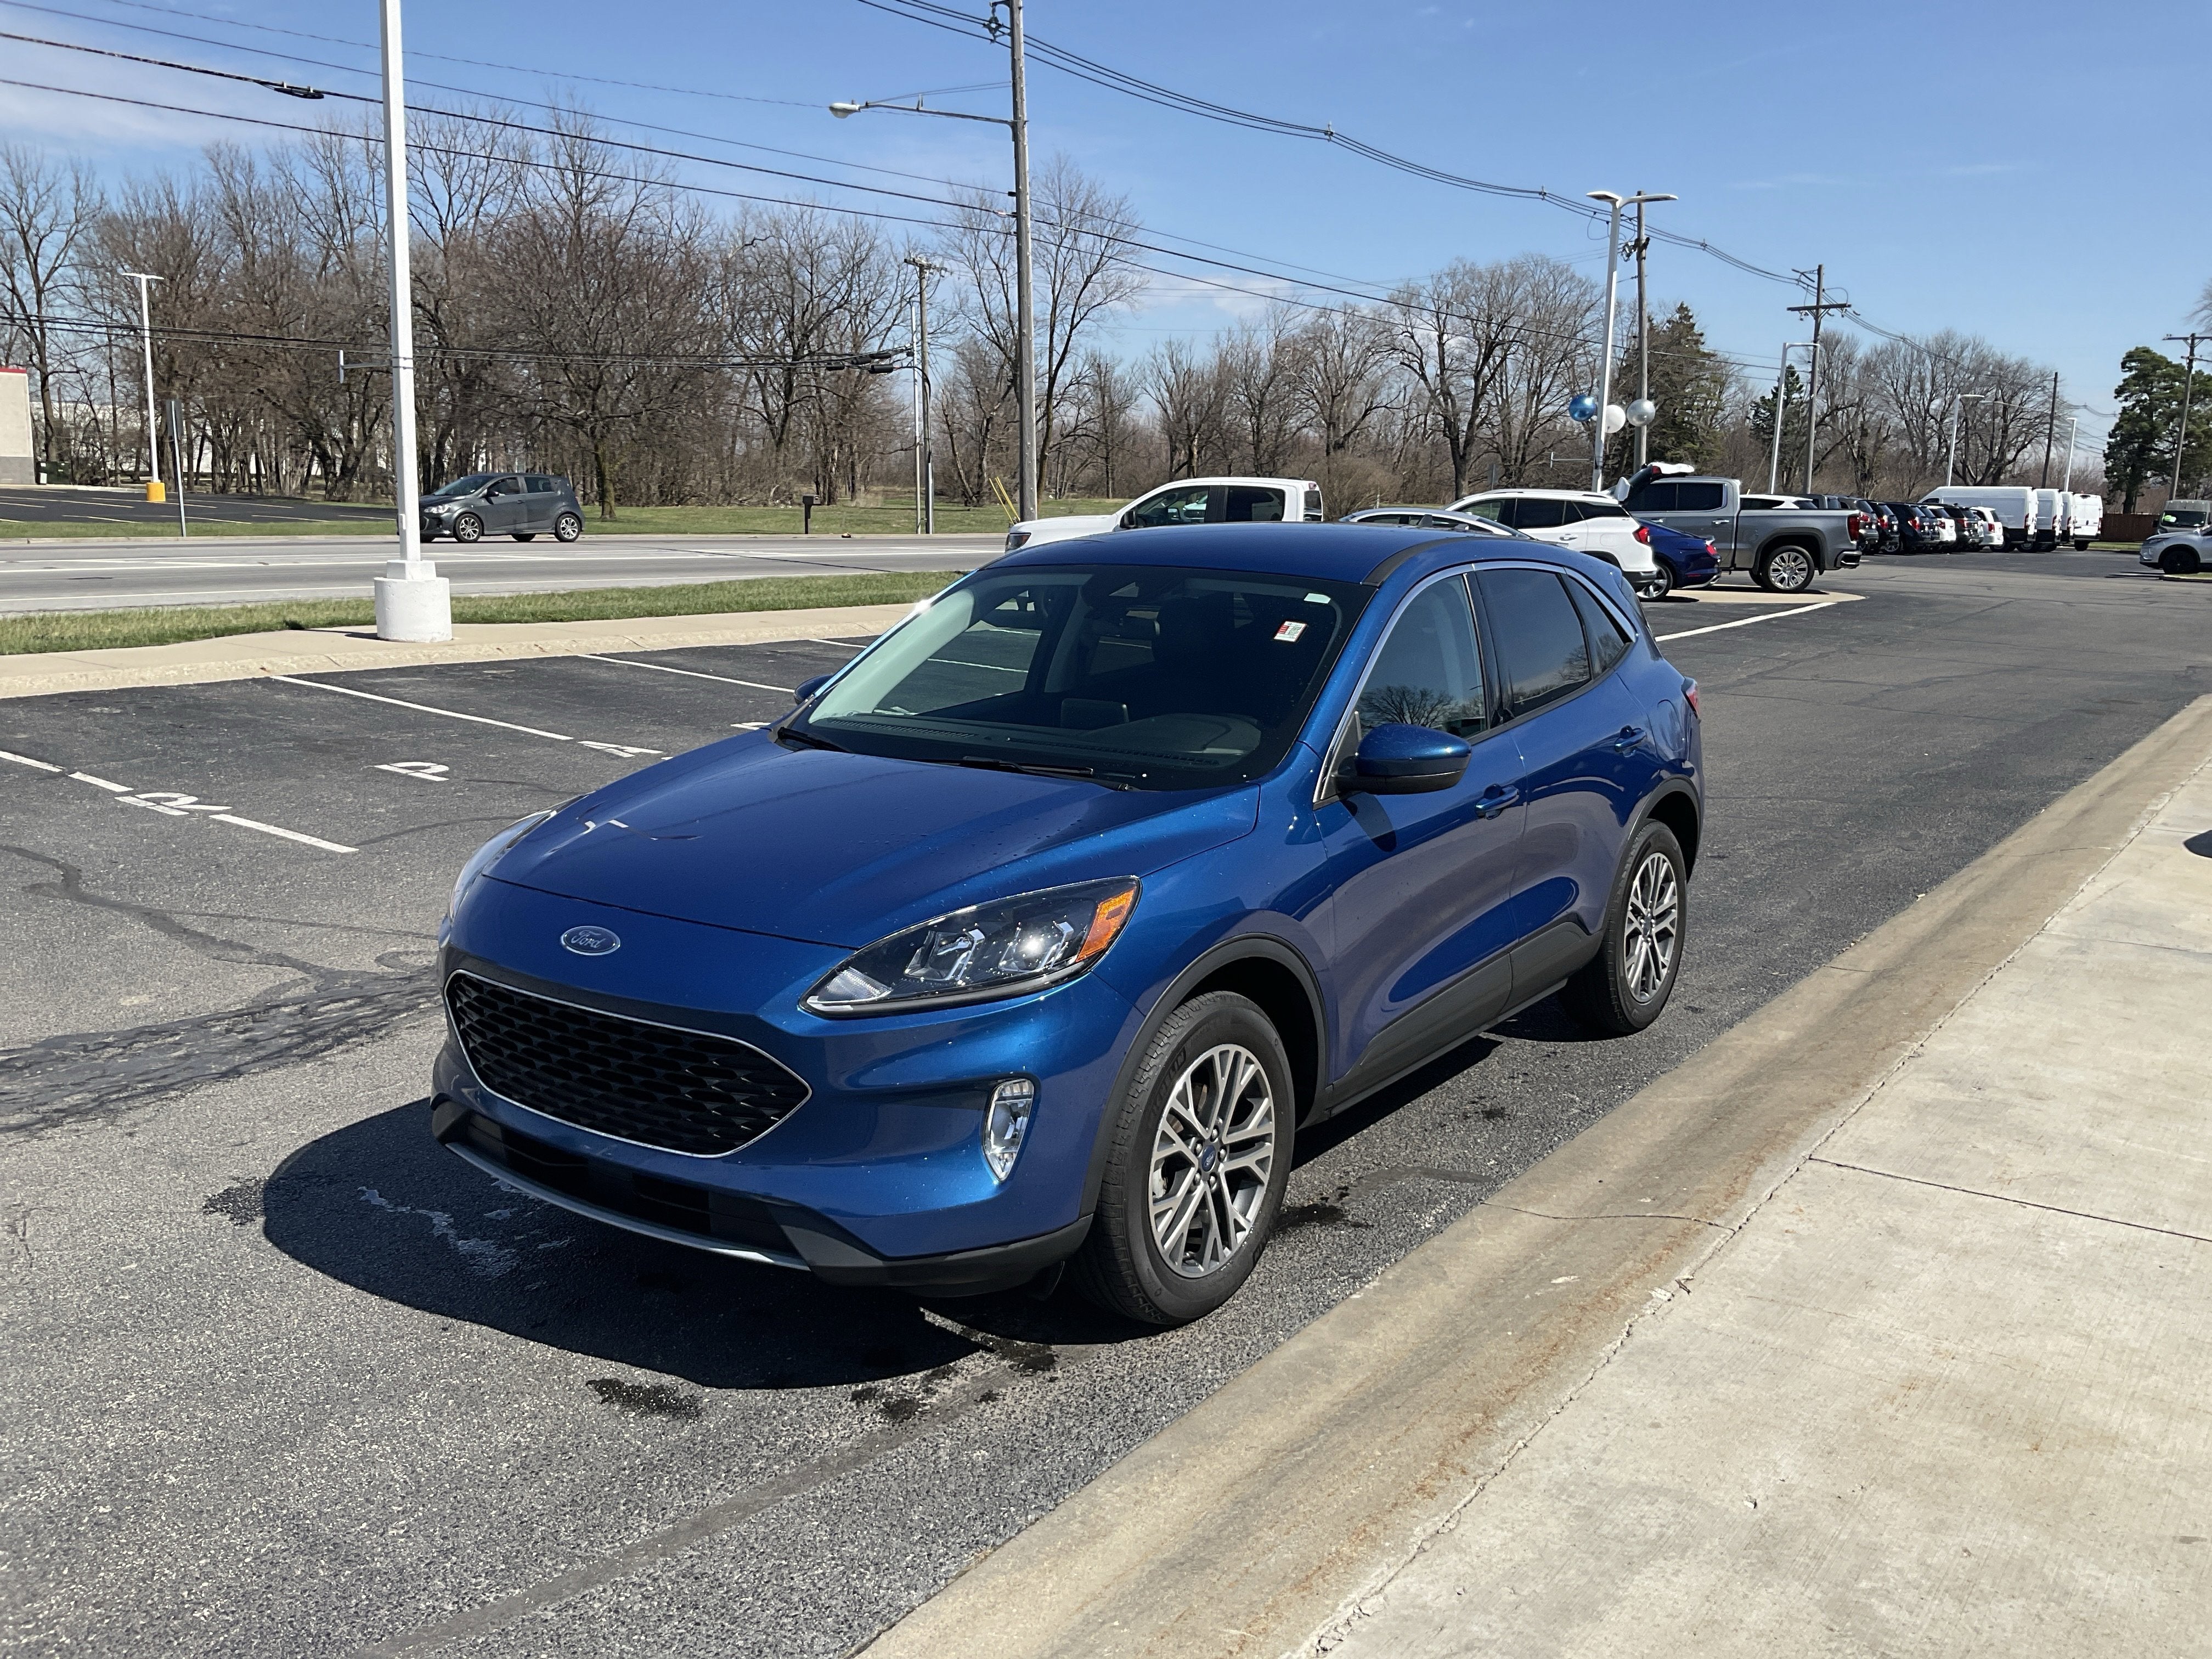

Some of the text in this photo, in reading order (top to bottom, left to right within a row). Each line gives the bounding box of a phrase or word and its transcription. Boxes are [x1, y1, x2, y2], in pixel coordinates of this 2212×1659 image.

[114, 792, 233, 816] R
[374, 761, 449, 782] P
[571, 930, 605, 948] Ford
